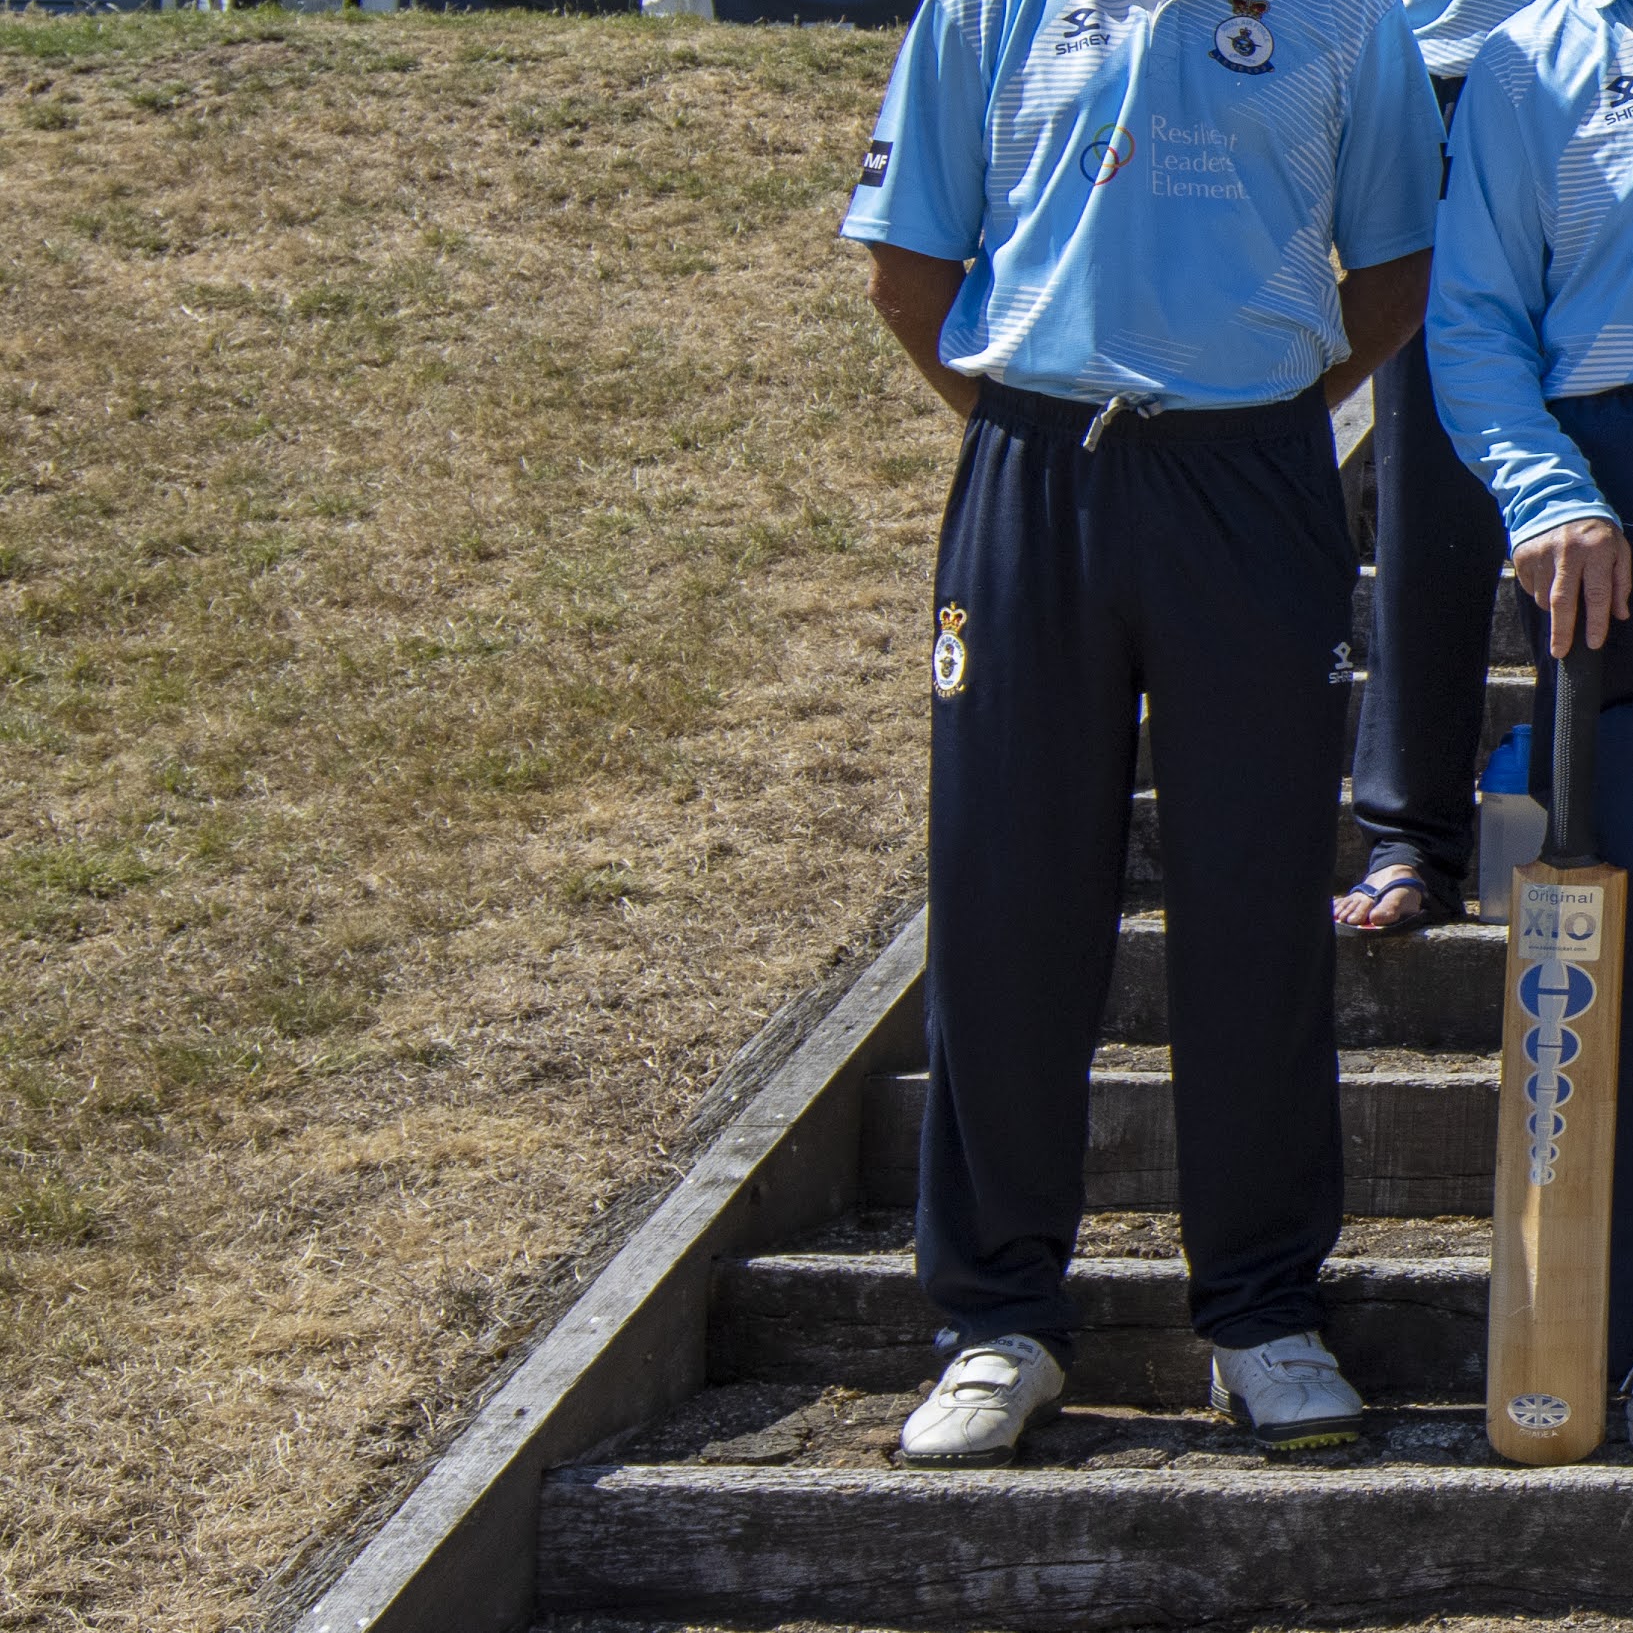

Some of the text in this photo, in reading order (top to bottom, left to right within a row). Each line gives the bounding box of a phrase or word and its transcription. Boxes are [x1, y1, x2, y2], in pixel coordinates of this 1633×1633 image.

[1055, 34, 1111, 56] SHREY
[1151, 142, 1234, 173] Leaders
[1528, 889, 1593, 905] Original
[1519, 1428, 1559, 1439] GRADE A
